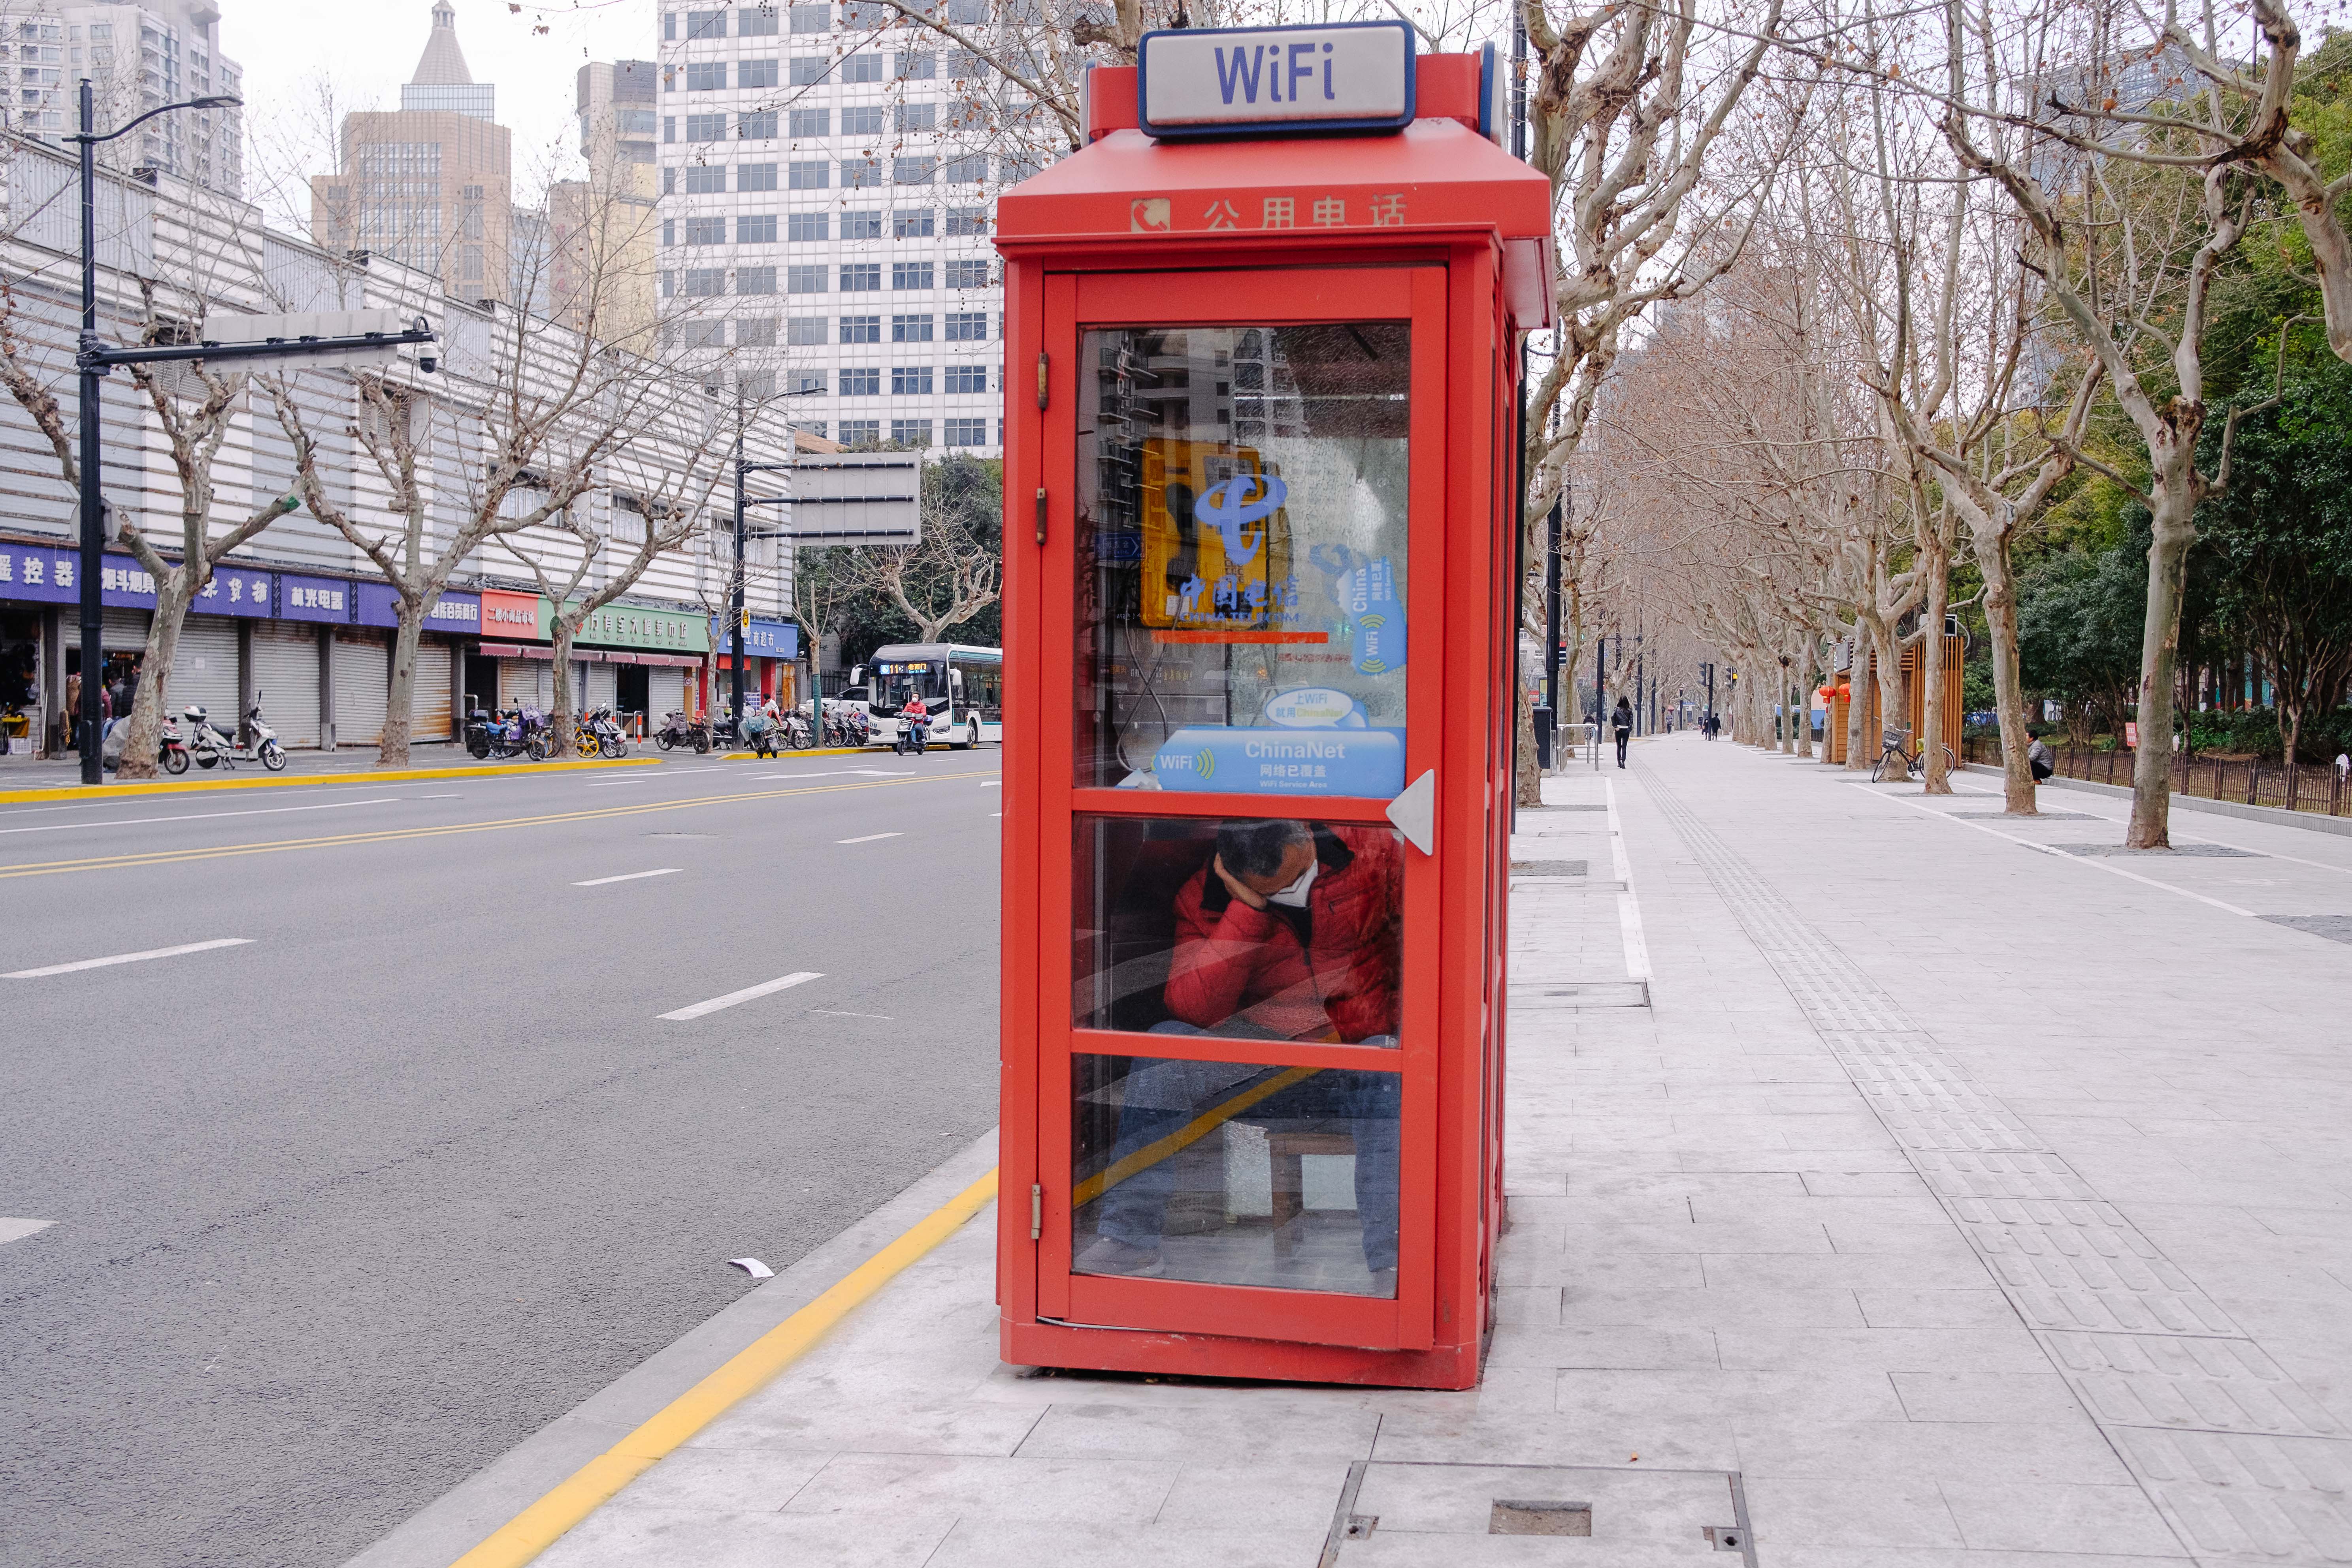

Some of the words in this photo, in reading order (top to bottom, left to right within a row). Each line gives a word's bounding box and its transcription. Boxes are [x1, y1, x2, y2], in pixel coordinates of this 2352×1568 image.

[1214, 42, 1335, 104] WiFi
[1204, 193, 1407, 230] 公用电话
[101, 567, 156, 594] 烟斗烟具
[1180, 573, 1298, 610] 中国电信
[1352, 568, 1368, 612] China
[488, 607, 534, 625] 二楼小商品市场
[1180, 612, 1225, 622] CHINA
[1230, 612, 1300, 622] TELECOM
[1365, 631, 1379, 656] WiFi
[890, 664, 898, 674] 11
[1295, 692, 1328, 705] 上WiFi
[1245, 741, 1346, 759] ChinaNet
[1160, 755, 1193, 769] WiFi
[1260, 764, 1326, 778] 网络已覆盖
[1279, 780, 1307, 788] Service
